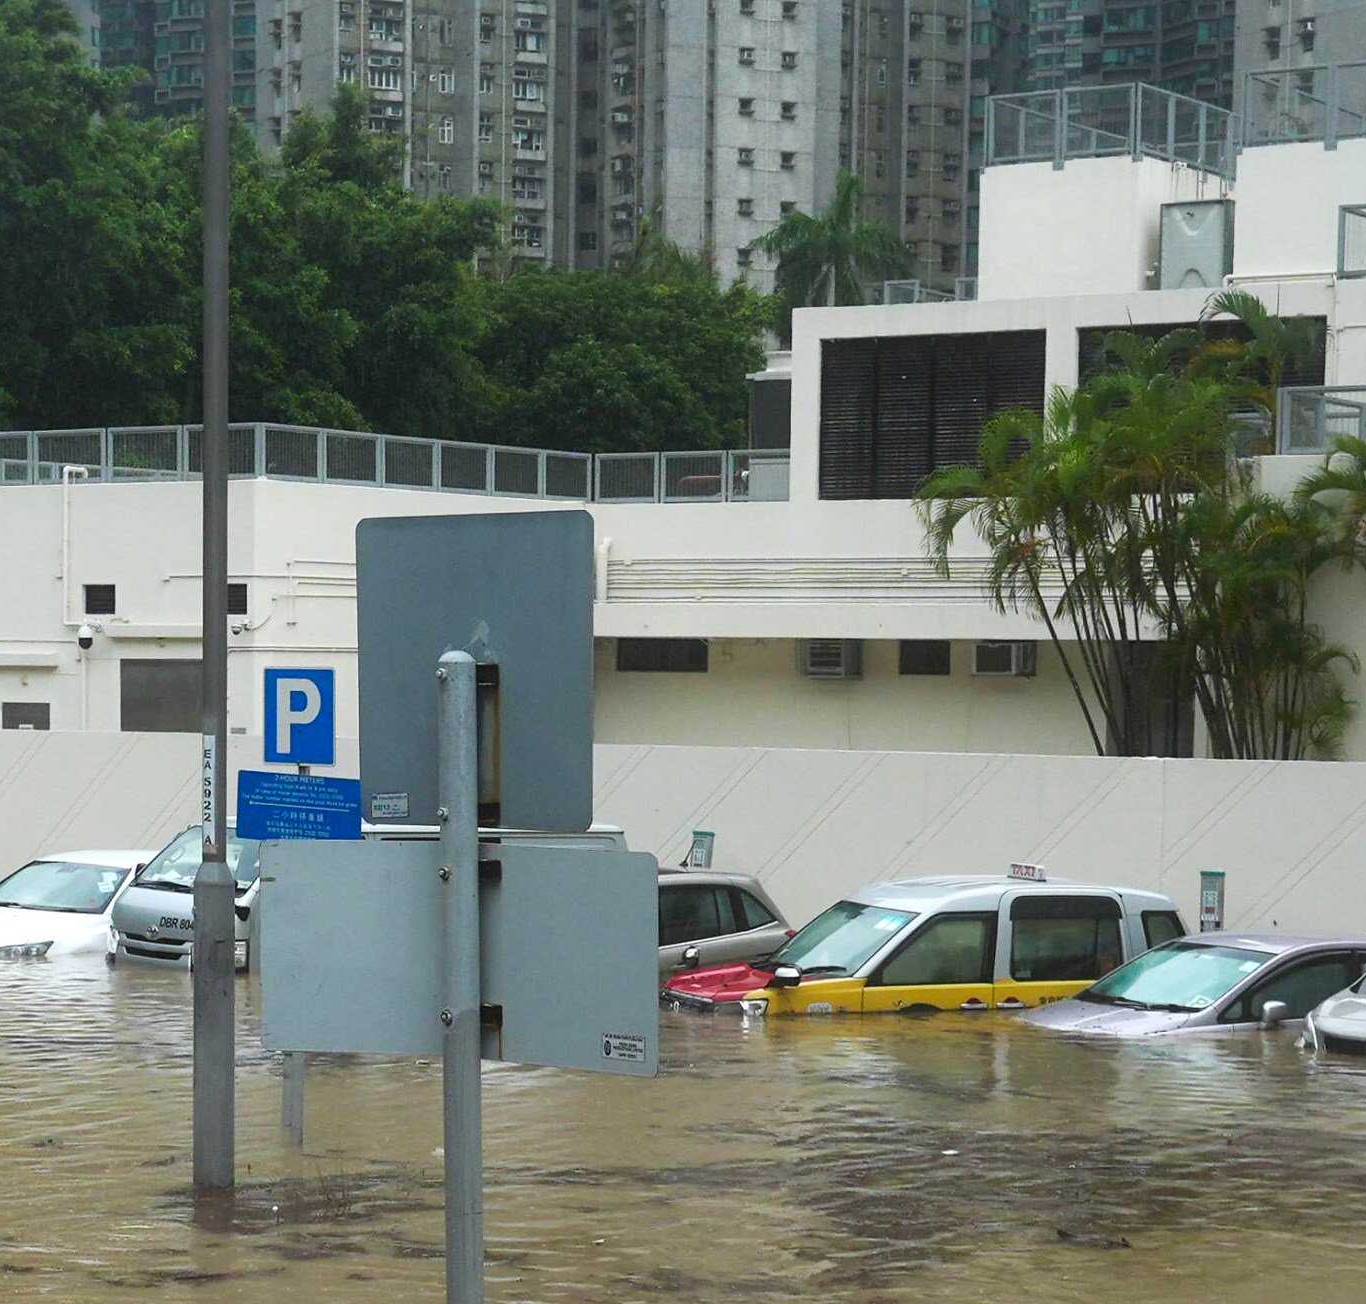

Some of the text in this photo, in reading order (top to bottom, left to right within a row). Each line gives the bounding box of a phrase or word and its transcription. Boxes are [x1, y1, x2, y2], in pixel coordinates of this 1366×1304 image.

[276, 678, 321, 754] P
[1011, 864, 1036, 877] TAXI
[159, 916, 179, 929] DBR
